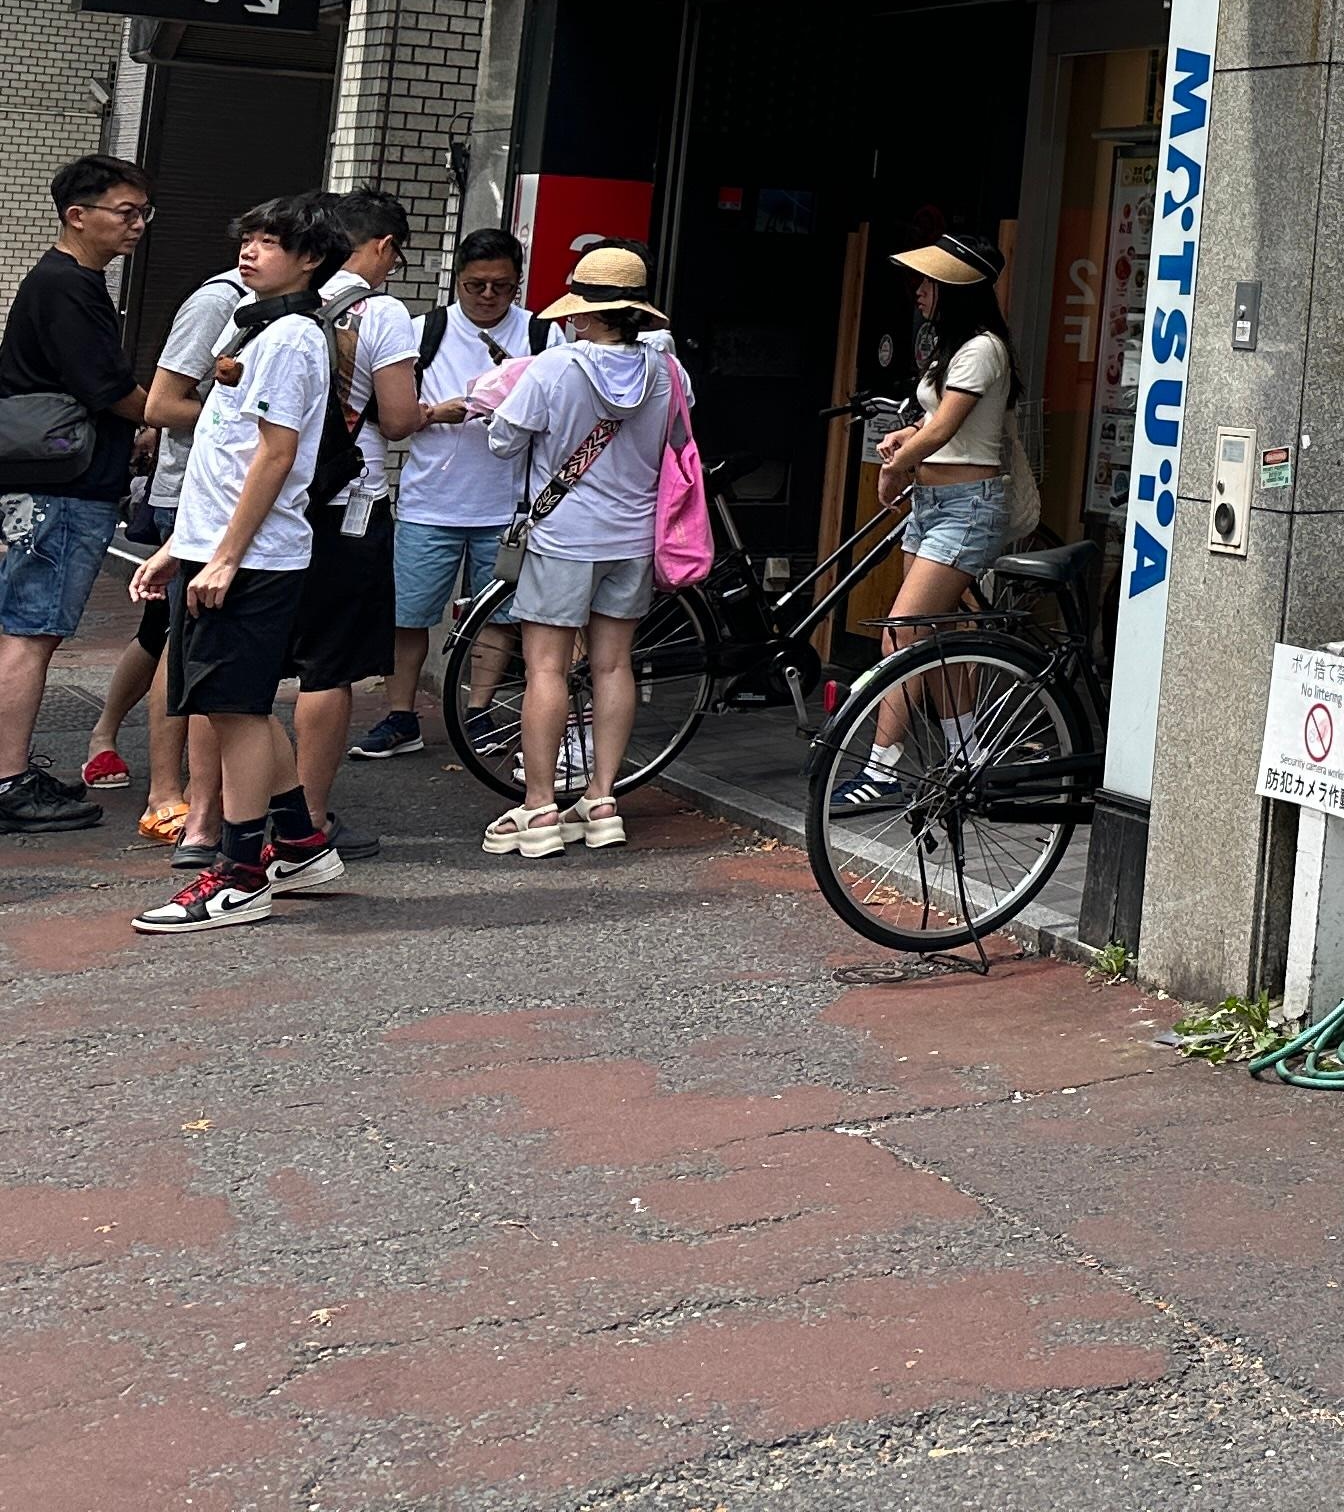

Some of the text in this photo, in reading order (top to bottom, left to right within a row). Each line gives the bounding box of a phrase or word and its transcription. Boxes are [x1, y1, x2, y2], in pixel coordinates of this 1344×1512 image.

[1128, 47, 1211, 600] MATSUYA
[1301, 682, 1343, 709] No littering
[1280, 752, 1306, 770] Security
[1306, 762, 1327, 776] camera
